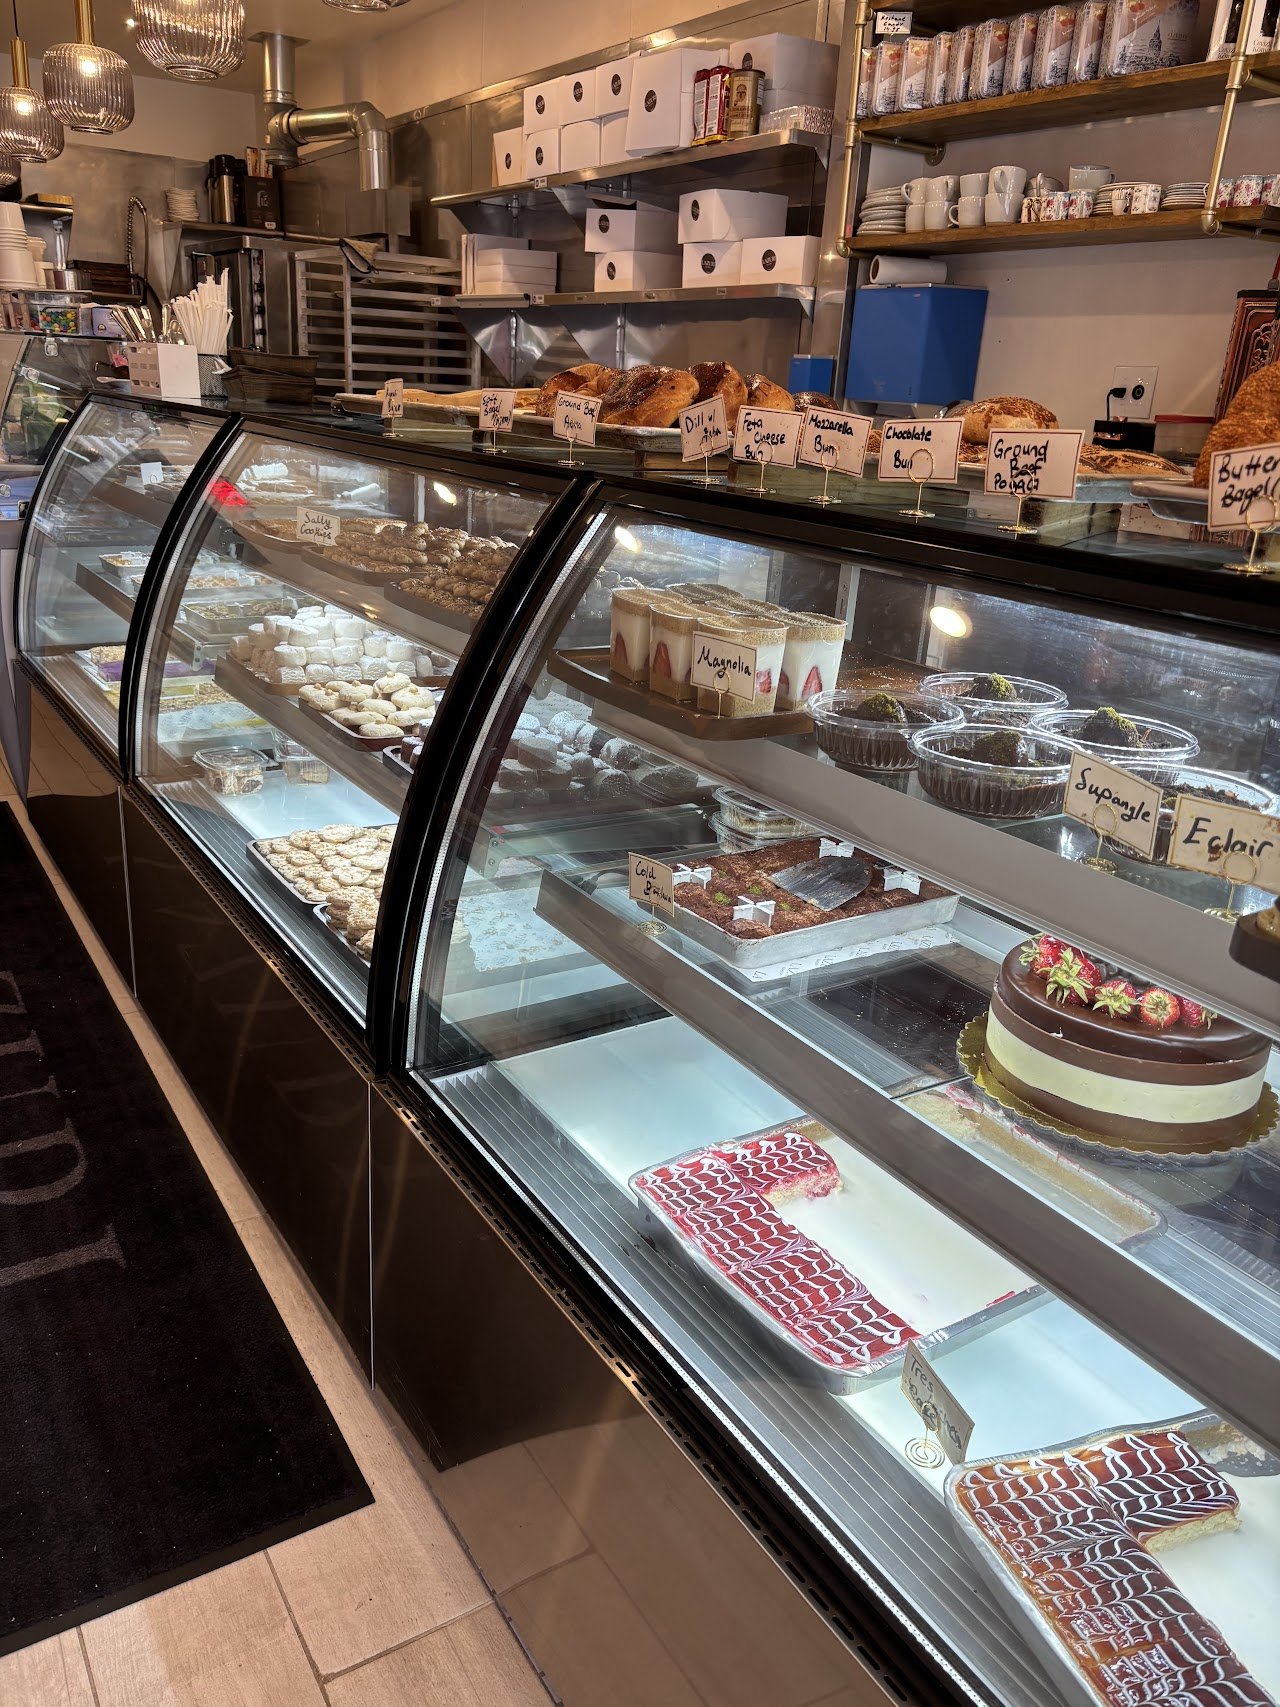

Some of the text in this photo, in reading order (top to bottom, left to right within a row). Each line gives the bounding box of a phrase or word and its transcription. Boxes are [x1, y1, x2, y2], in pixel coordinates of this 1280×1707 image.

[558, 397, 581, 411] Ground
[685, 411, 704, 434] Dill
[743, 412, 763, 432] Feta
[809, 414, 854, 436] Mozzarella
[754, 432, 786, 445] Cheese
[885, 425, 932, 441] Chocolate
[745, 444, 764, 460] Bun
[814, 435, 835, 456] Bun
[993, 438, 1049, 463] Ground
[893, 449, 913, 469] Bun
[1009, 456, 1043, 478] Beef
[1218, 453, 1280, 484] Butter
[304, 511, 333, 531] Salty
[300, 523, 332, 541] Cookies
[697, 645, 752, 678] Magnolia
[1074, 767, 1151, 823] Supangle
[1182, 816, 1274, 858] Eclair
[635, 860, 657, 880] Cold
[911, 1353, 934, 1393] Tres
